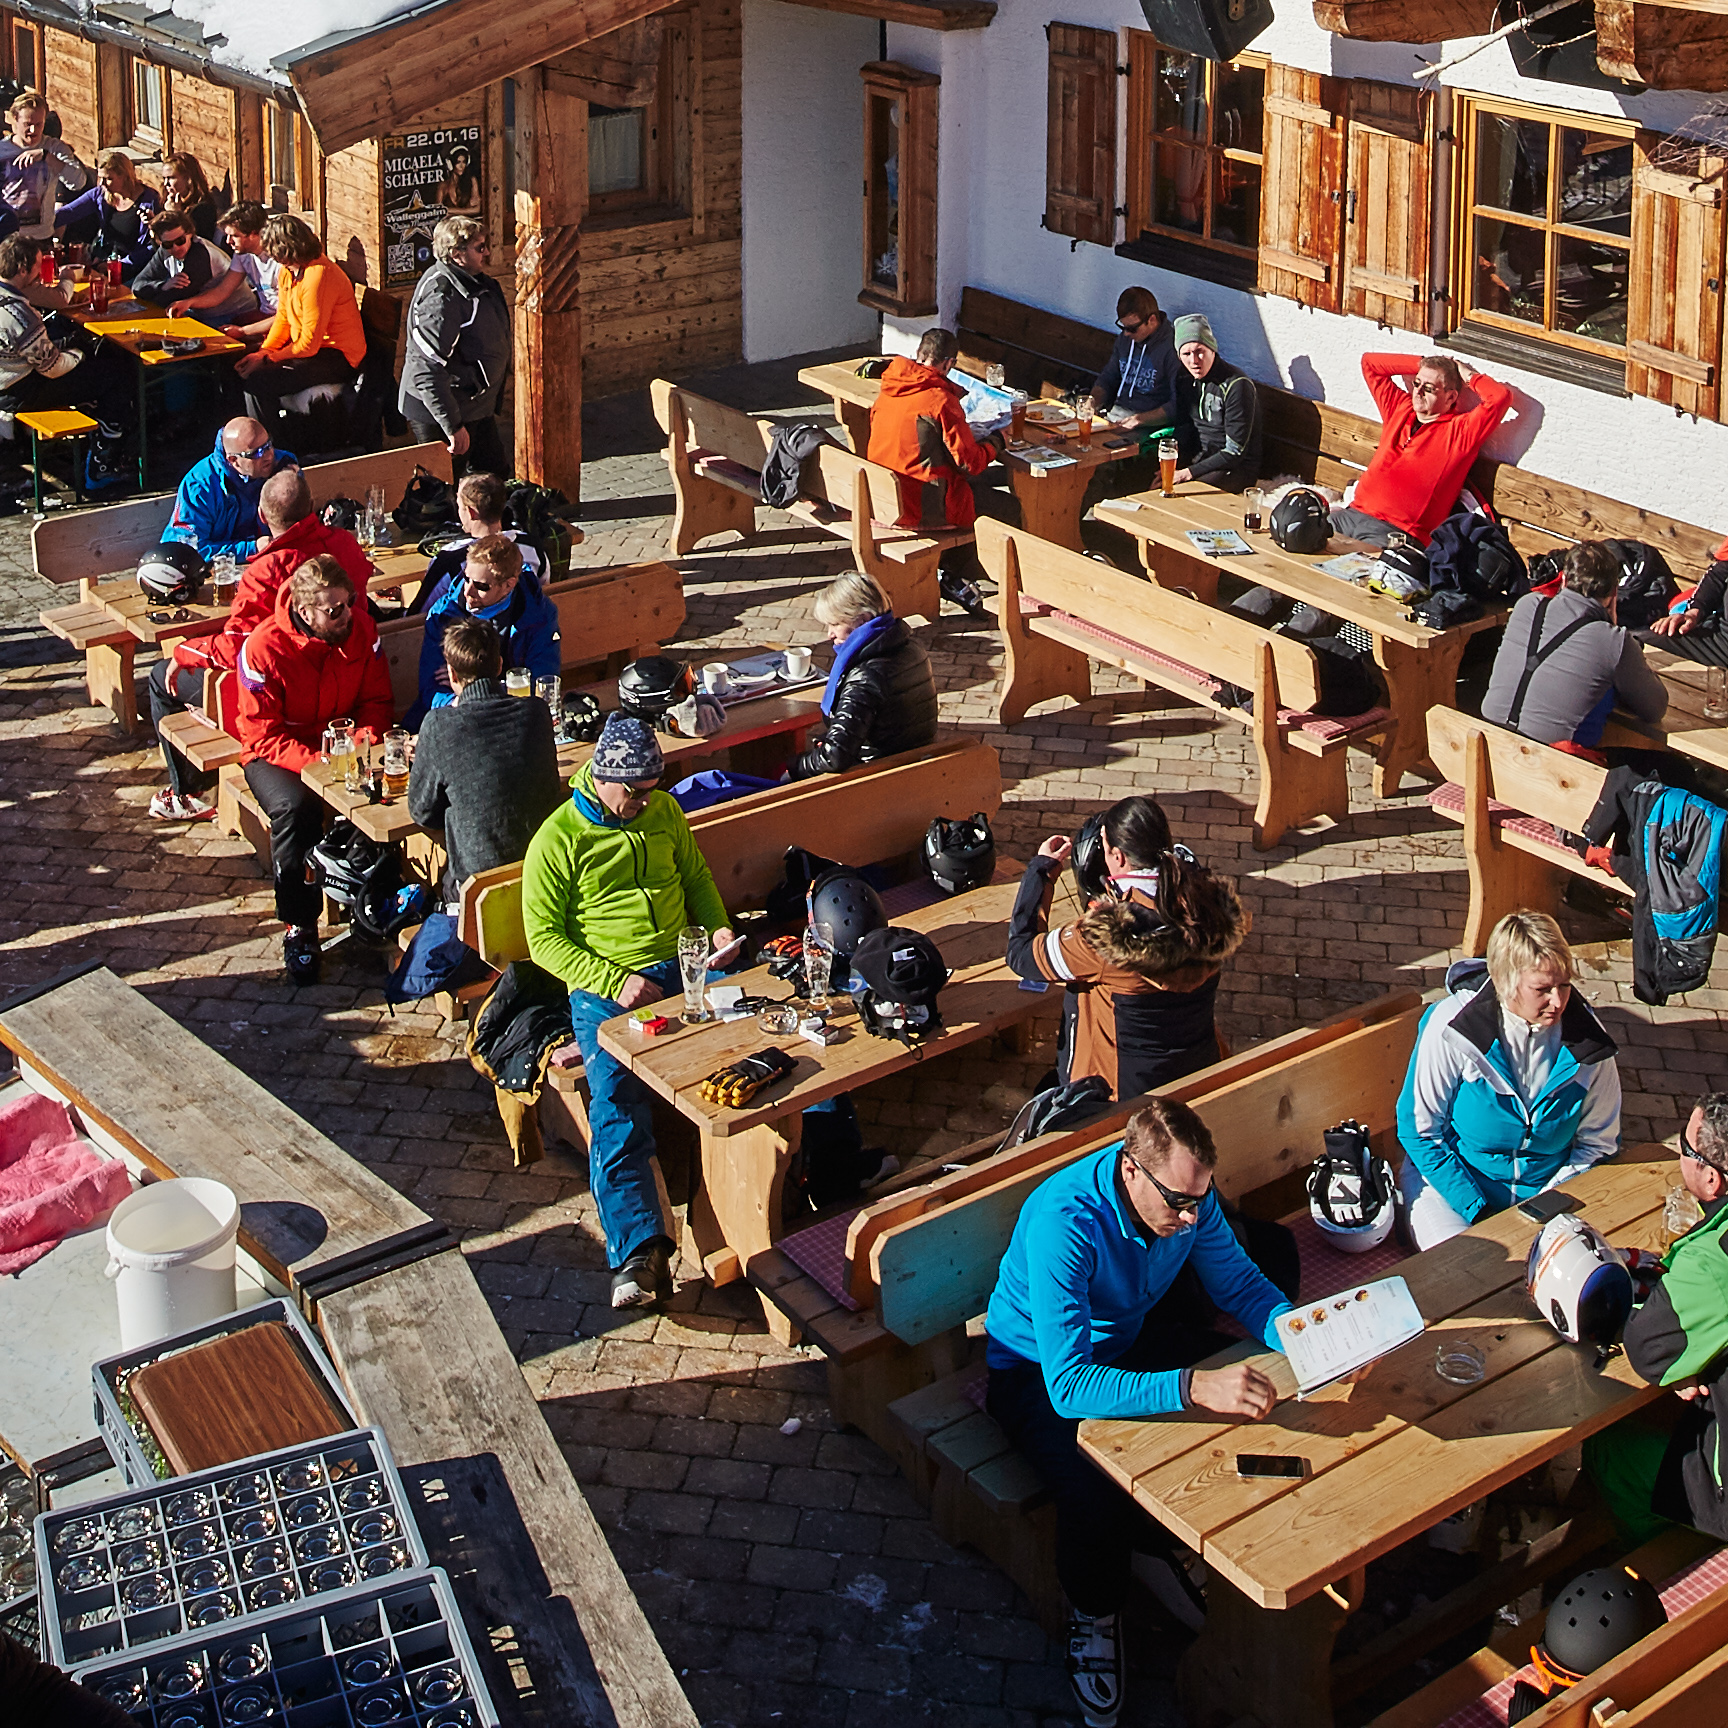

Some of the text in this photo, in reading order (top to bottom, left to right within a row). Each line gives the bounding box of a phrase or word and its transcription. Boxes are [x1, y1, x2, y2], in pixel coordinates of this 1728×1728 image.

[384, 127, 479, 150] FR 22.01.16
[384, 153, 443, 173] MICAELA
[324, 876, 351, 891] SMITH
